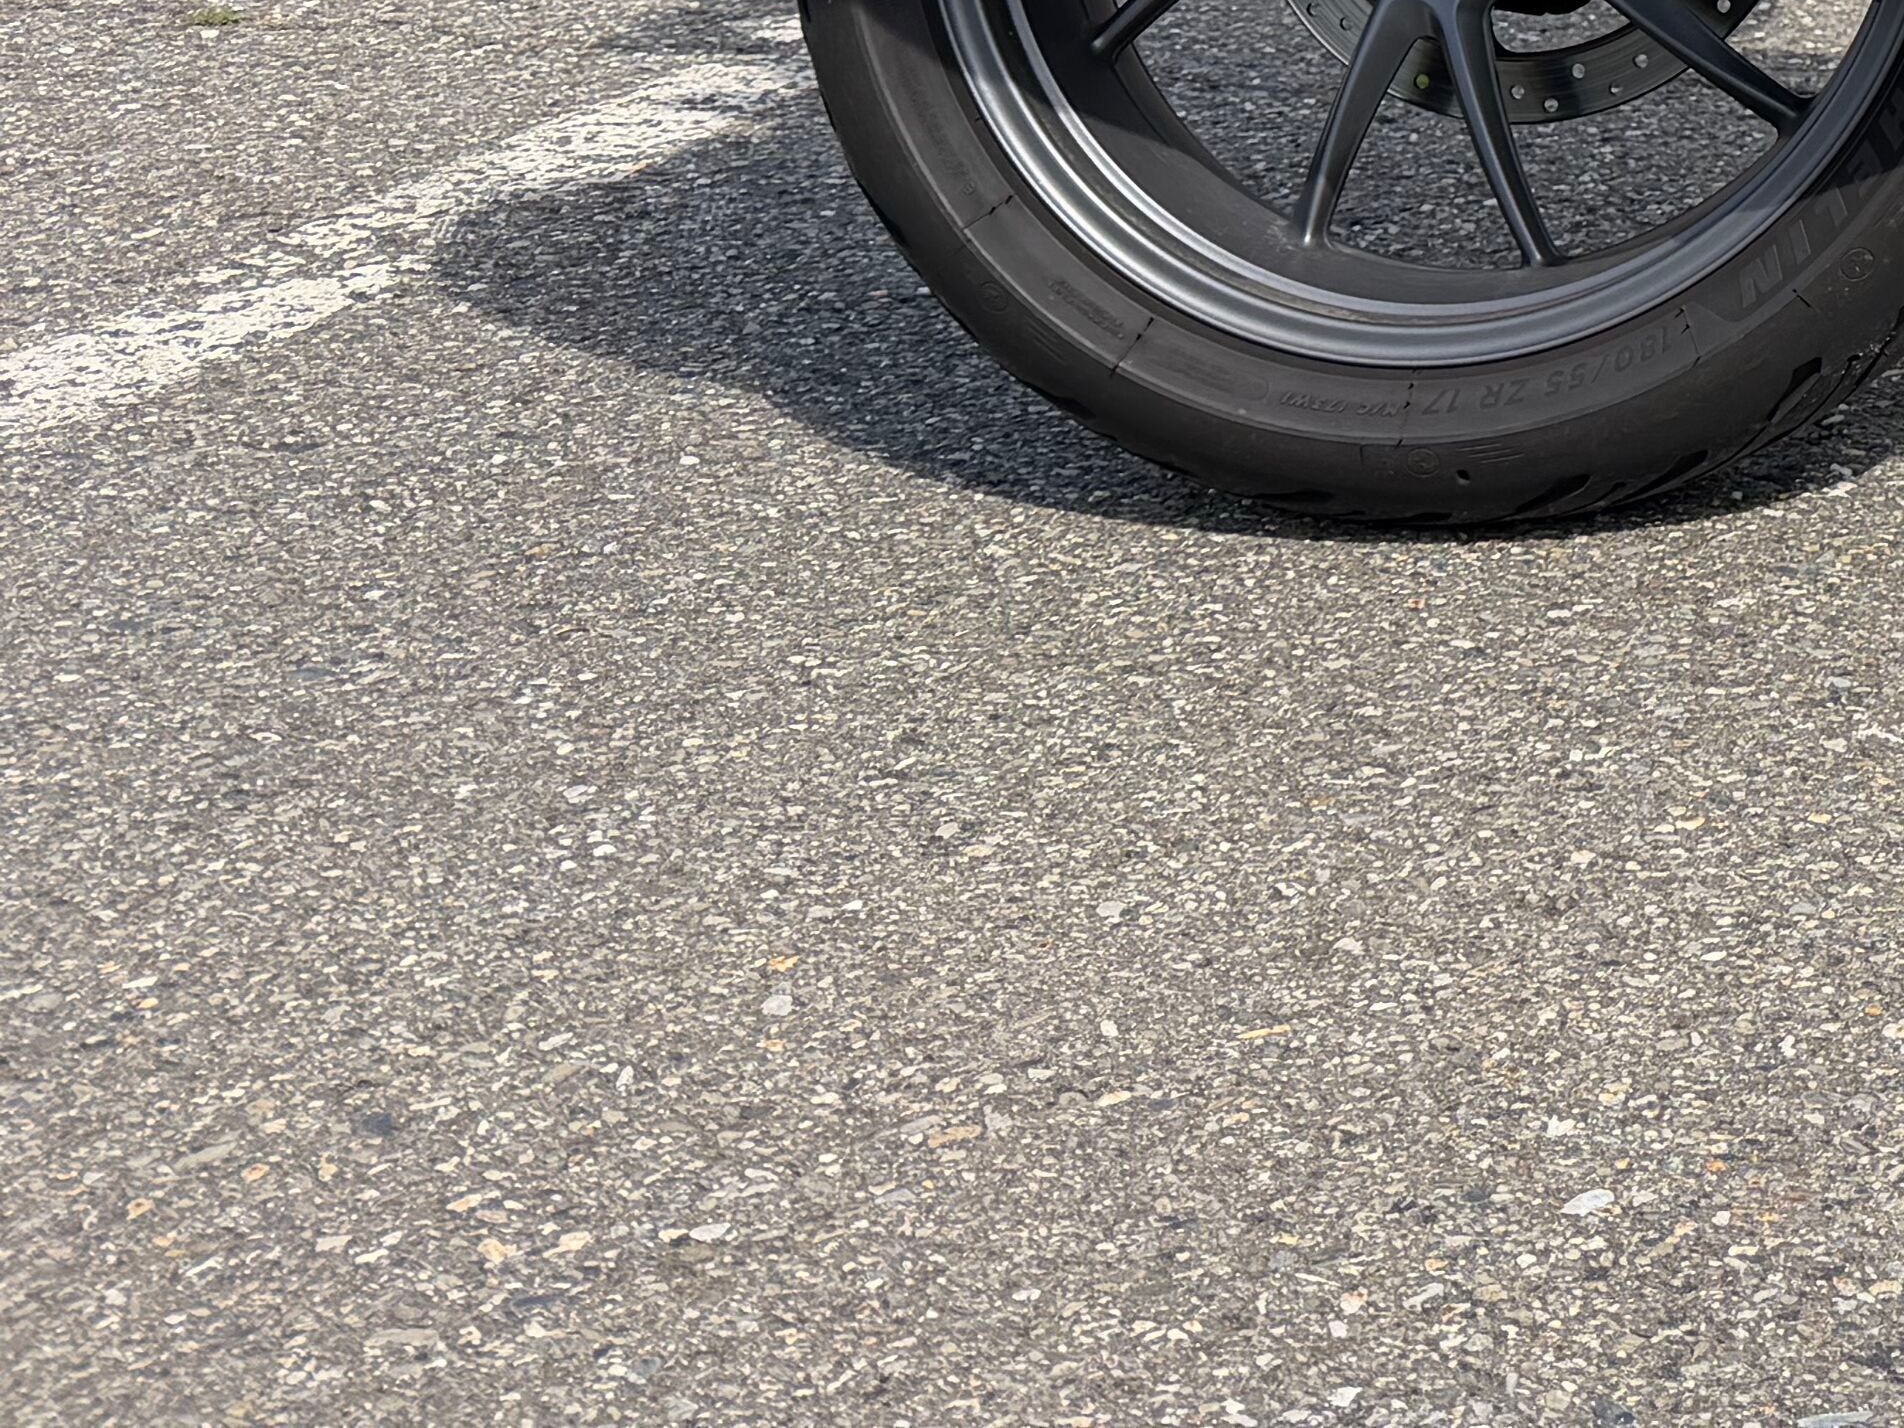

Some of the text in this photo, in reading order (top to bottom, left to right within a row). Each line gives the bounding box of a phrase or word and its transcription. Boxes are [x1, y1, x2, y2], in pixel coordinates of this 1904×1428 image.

[1544, 328, 1673, 397] 180/55
[1421, 387, 1462, 417] 17
[1479, 377, 1531, 411] ZR
